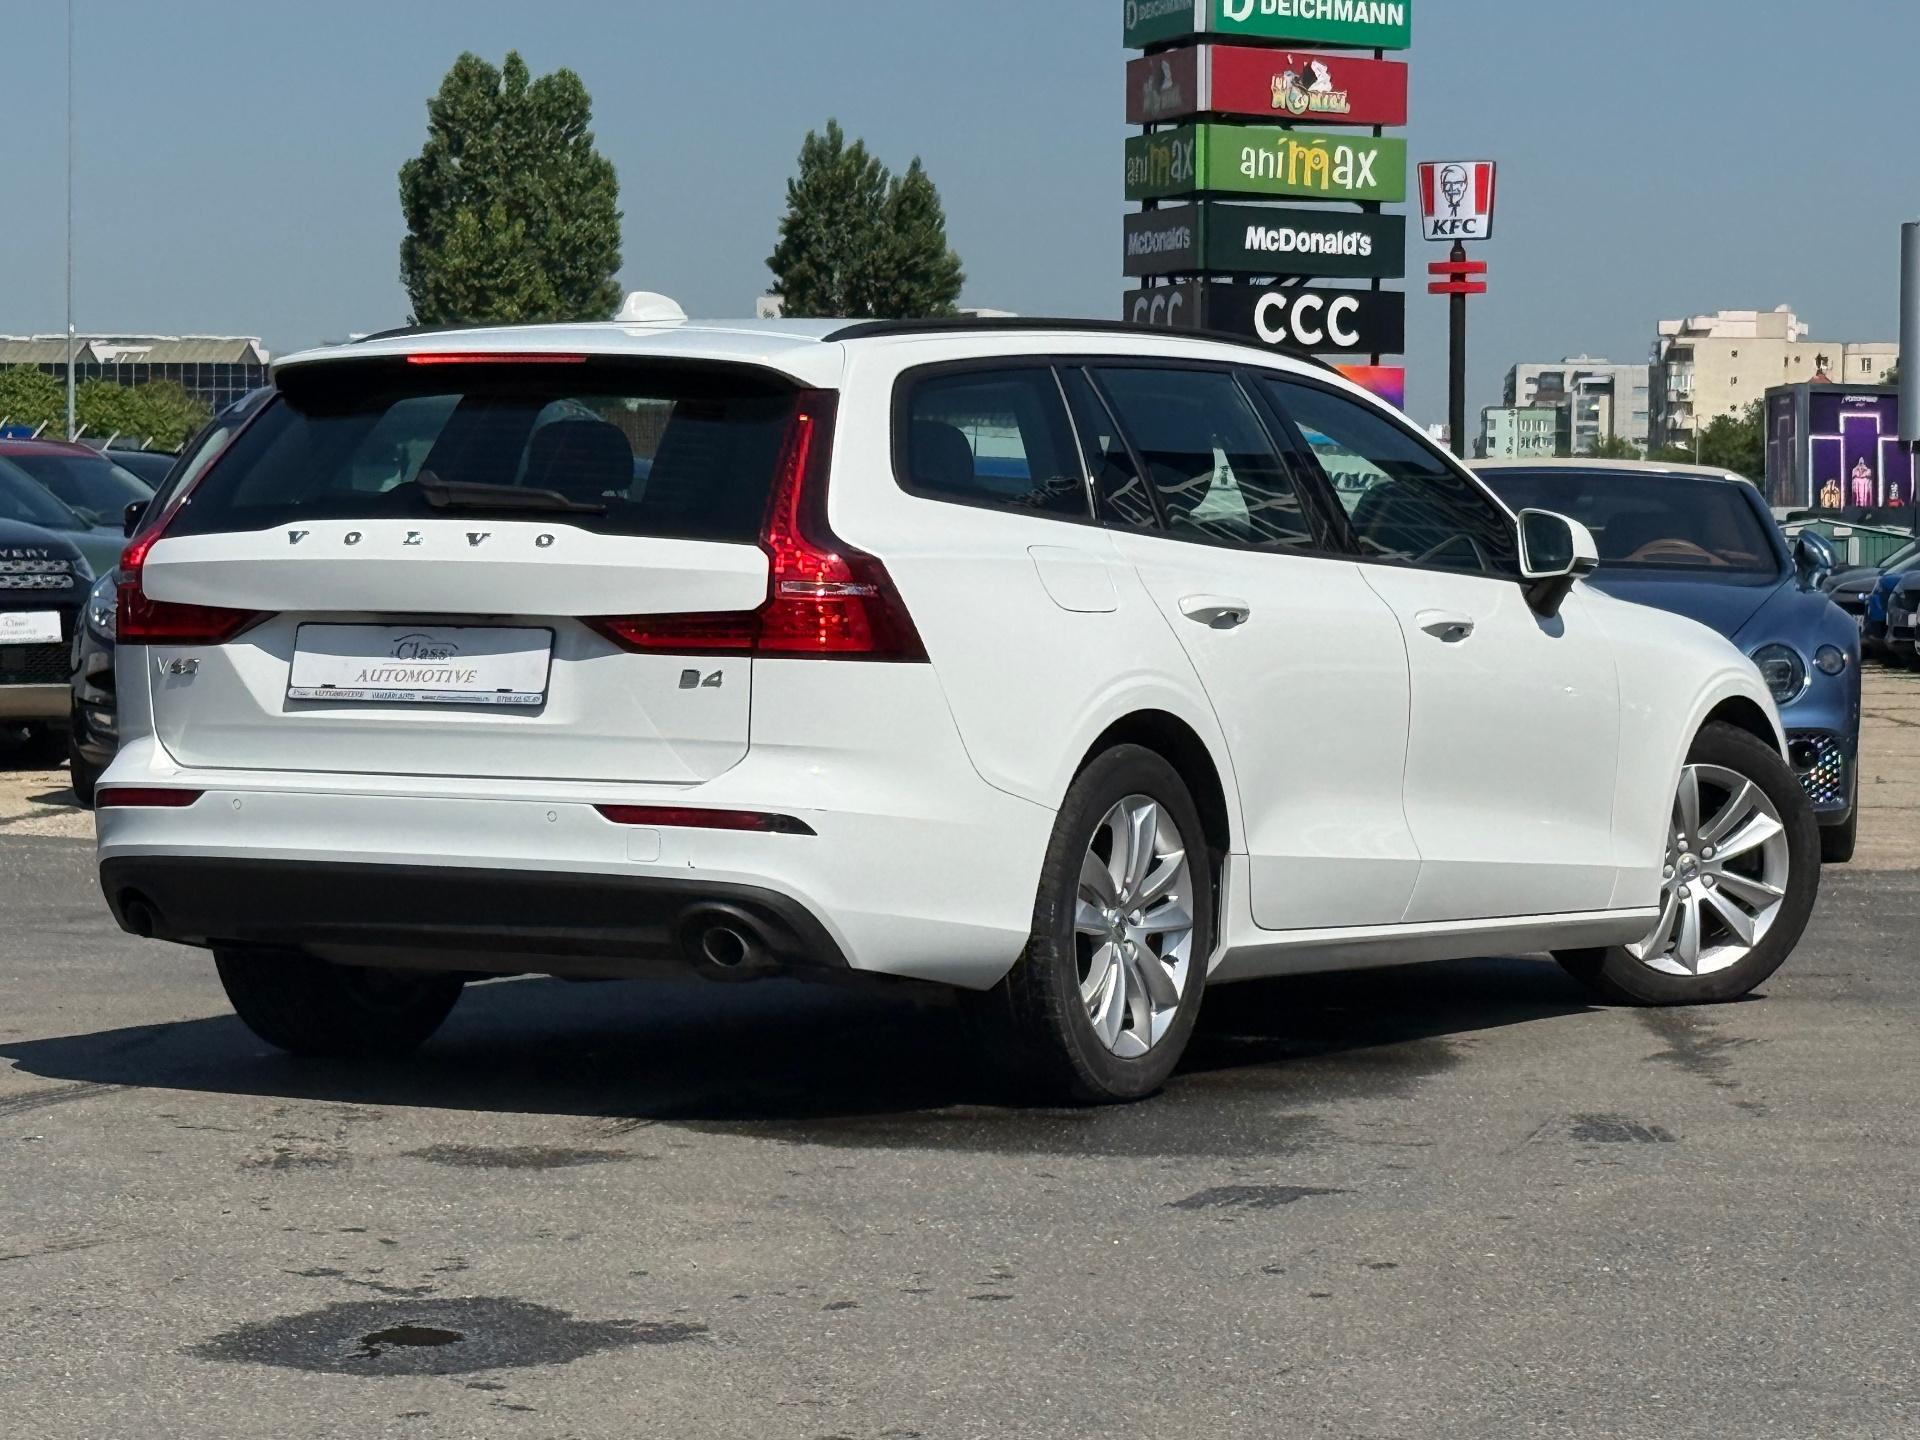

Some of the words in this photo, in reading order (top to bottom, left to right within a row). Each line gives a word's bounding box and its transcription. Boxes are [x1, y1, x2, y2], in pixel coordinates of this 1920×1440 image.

[1261, 0, 1403, 26] DEICHMANN
[1240, 137, 1378, 190] animax
[1431, 218, 1477, 236] KFC
[1127, 225, 1191, 256] McDonald's
[1245, 226, 1372, 256] McDonald's
[1254, 292, 1359, 346] CCC
[288, 530, 555, 549] VOLVO
[397, 642, 447, 660] Class
[355, 668, 478, 683] AUTOMOTIVE
[679, 669, 723, 689] B4
